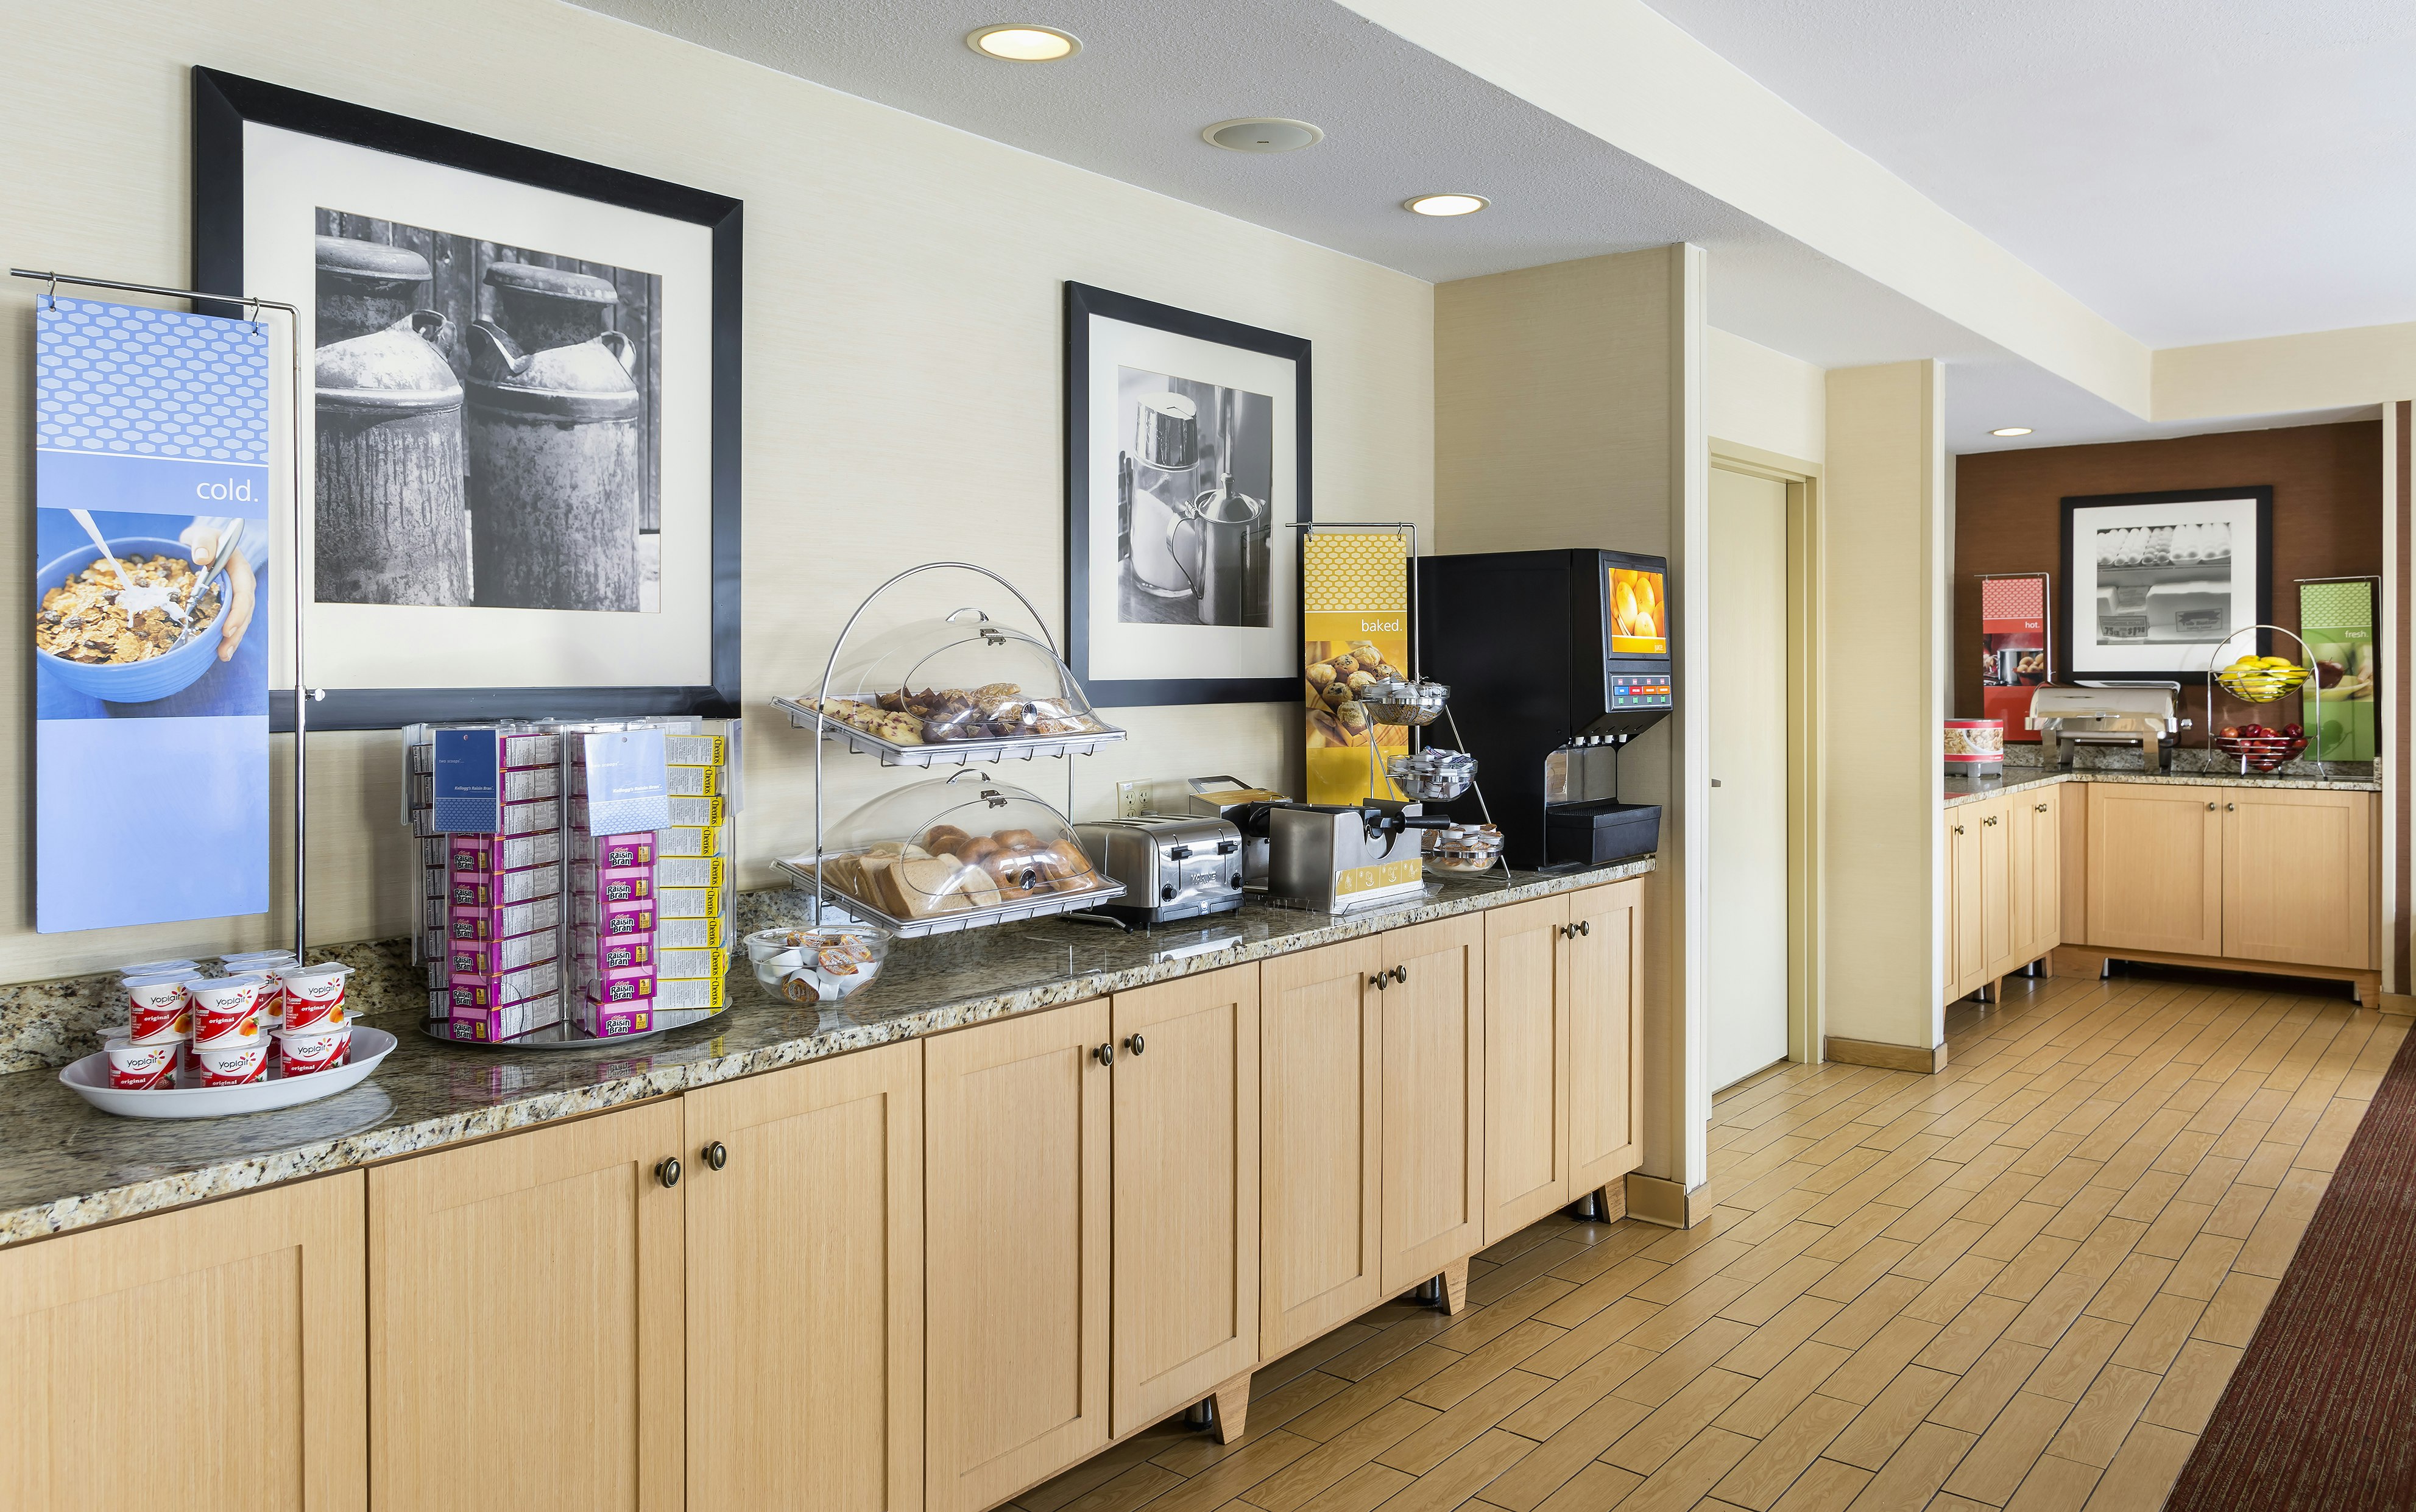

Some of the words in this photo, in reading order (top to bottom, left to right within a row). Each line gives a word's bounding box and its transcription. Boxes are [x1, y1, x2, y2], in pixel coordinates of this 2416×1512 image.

[197, 478, 258, 502] cold.
[1362, 619, 1402, 632] baked.
[454, 855, 474, 864] Raisin
[609, 852, 633, 861] Raisin
[612, 858, 630, 867] Bran
[712, 860, 720, 885] Cheerios
[454, 889, 474, 898] Raisin
[607, 885, 630, 894] Raisin
[609, 892, 628, 900] Bran
[453, 923, 473, 932] Raisin
[610, 918, 634, 928] Raisin
[613, 925, 632, 934] Bran
[453, 956, 473, 966] Raisin
[607, 952, 631, 962] Raisin
[609, 959, 628, 967] Bran
[308, 984, 335, 995] yoplait
[610, 985, 634, 995] Raisin
[151, 994, 181, 1005] yoplait
[453, 990, 473, 1000] Raisin
[613, 992, 632, 1001] Bran
[216, 997, 245, 1006] yoplait
[456, 997, 472, 1006] Bran
[453, 1023, 473, 1034] Raisin
[606, 1019, 630, 1030] Raisin
[456, 1031, 472, 1039] Bran
[609, 1026, 628, 1035] Bran
[297, 1044, 325, 1055] yoplait
[127, 1057, 158, 1067] yoplait
[219, 1059, 249, 1069] yoplait
